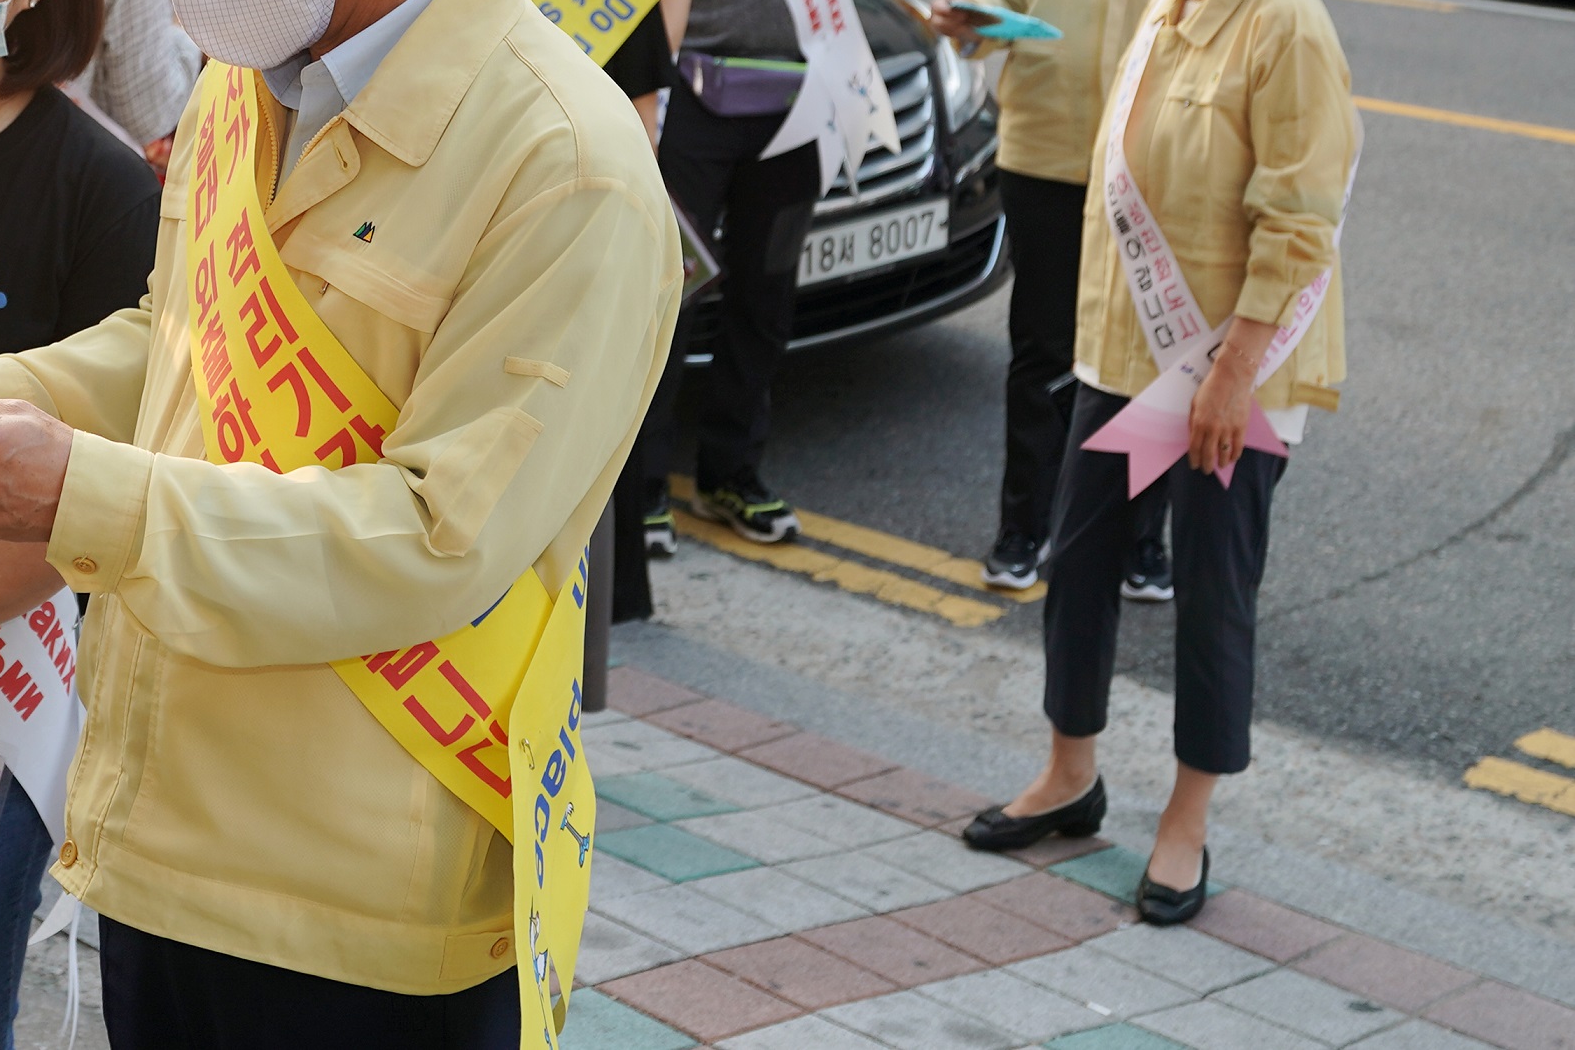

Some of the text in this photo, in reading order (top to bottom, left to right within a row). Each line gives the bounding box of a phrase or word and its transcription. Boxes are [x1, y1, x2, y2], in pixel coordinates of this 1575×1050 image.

[194, 95, 218, 243] 절대
[868, 210, 936, 260] 8007
[534, 676, 582, 890] place
